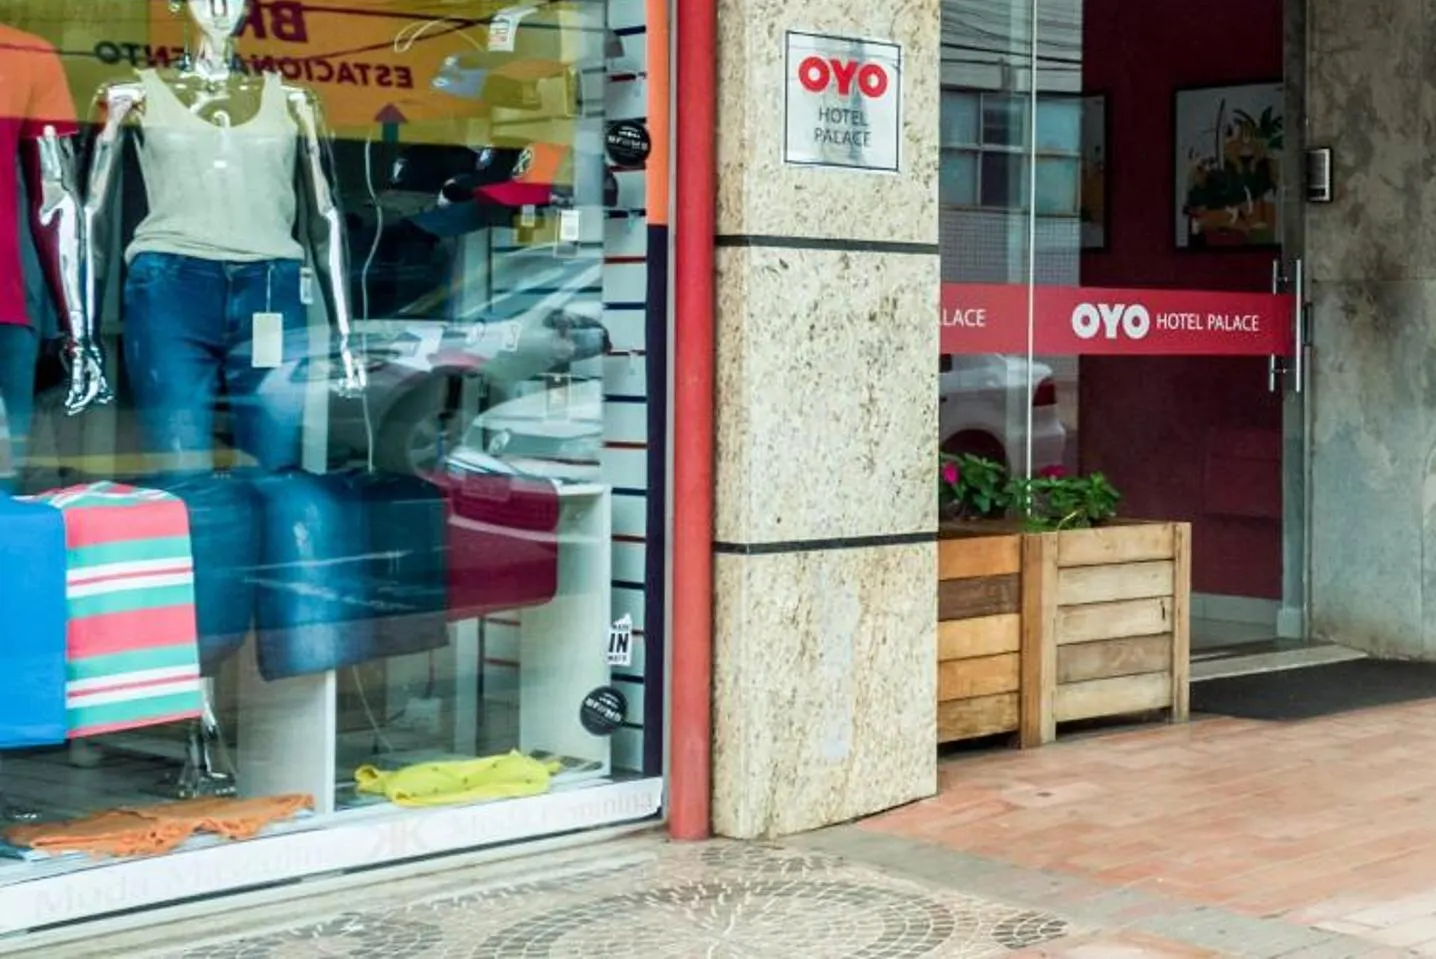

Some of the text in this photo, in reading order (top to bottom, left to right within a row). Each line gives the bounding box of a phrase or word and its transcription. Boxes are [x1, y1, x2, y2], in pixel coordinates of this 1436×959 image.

[798, 56, 889, 98] OYO
[819, 106, 868, 127] HOTEL
[814, 127, 871, 148] PALACE
[940, 308, 987, 328] LACE
[1072, 302, 1260, 340] OYO HOTEL PALACE
[608, 632, 630, 653] IN
